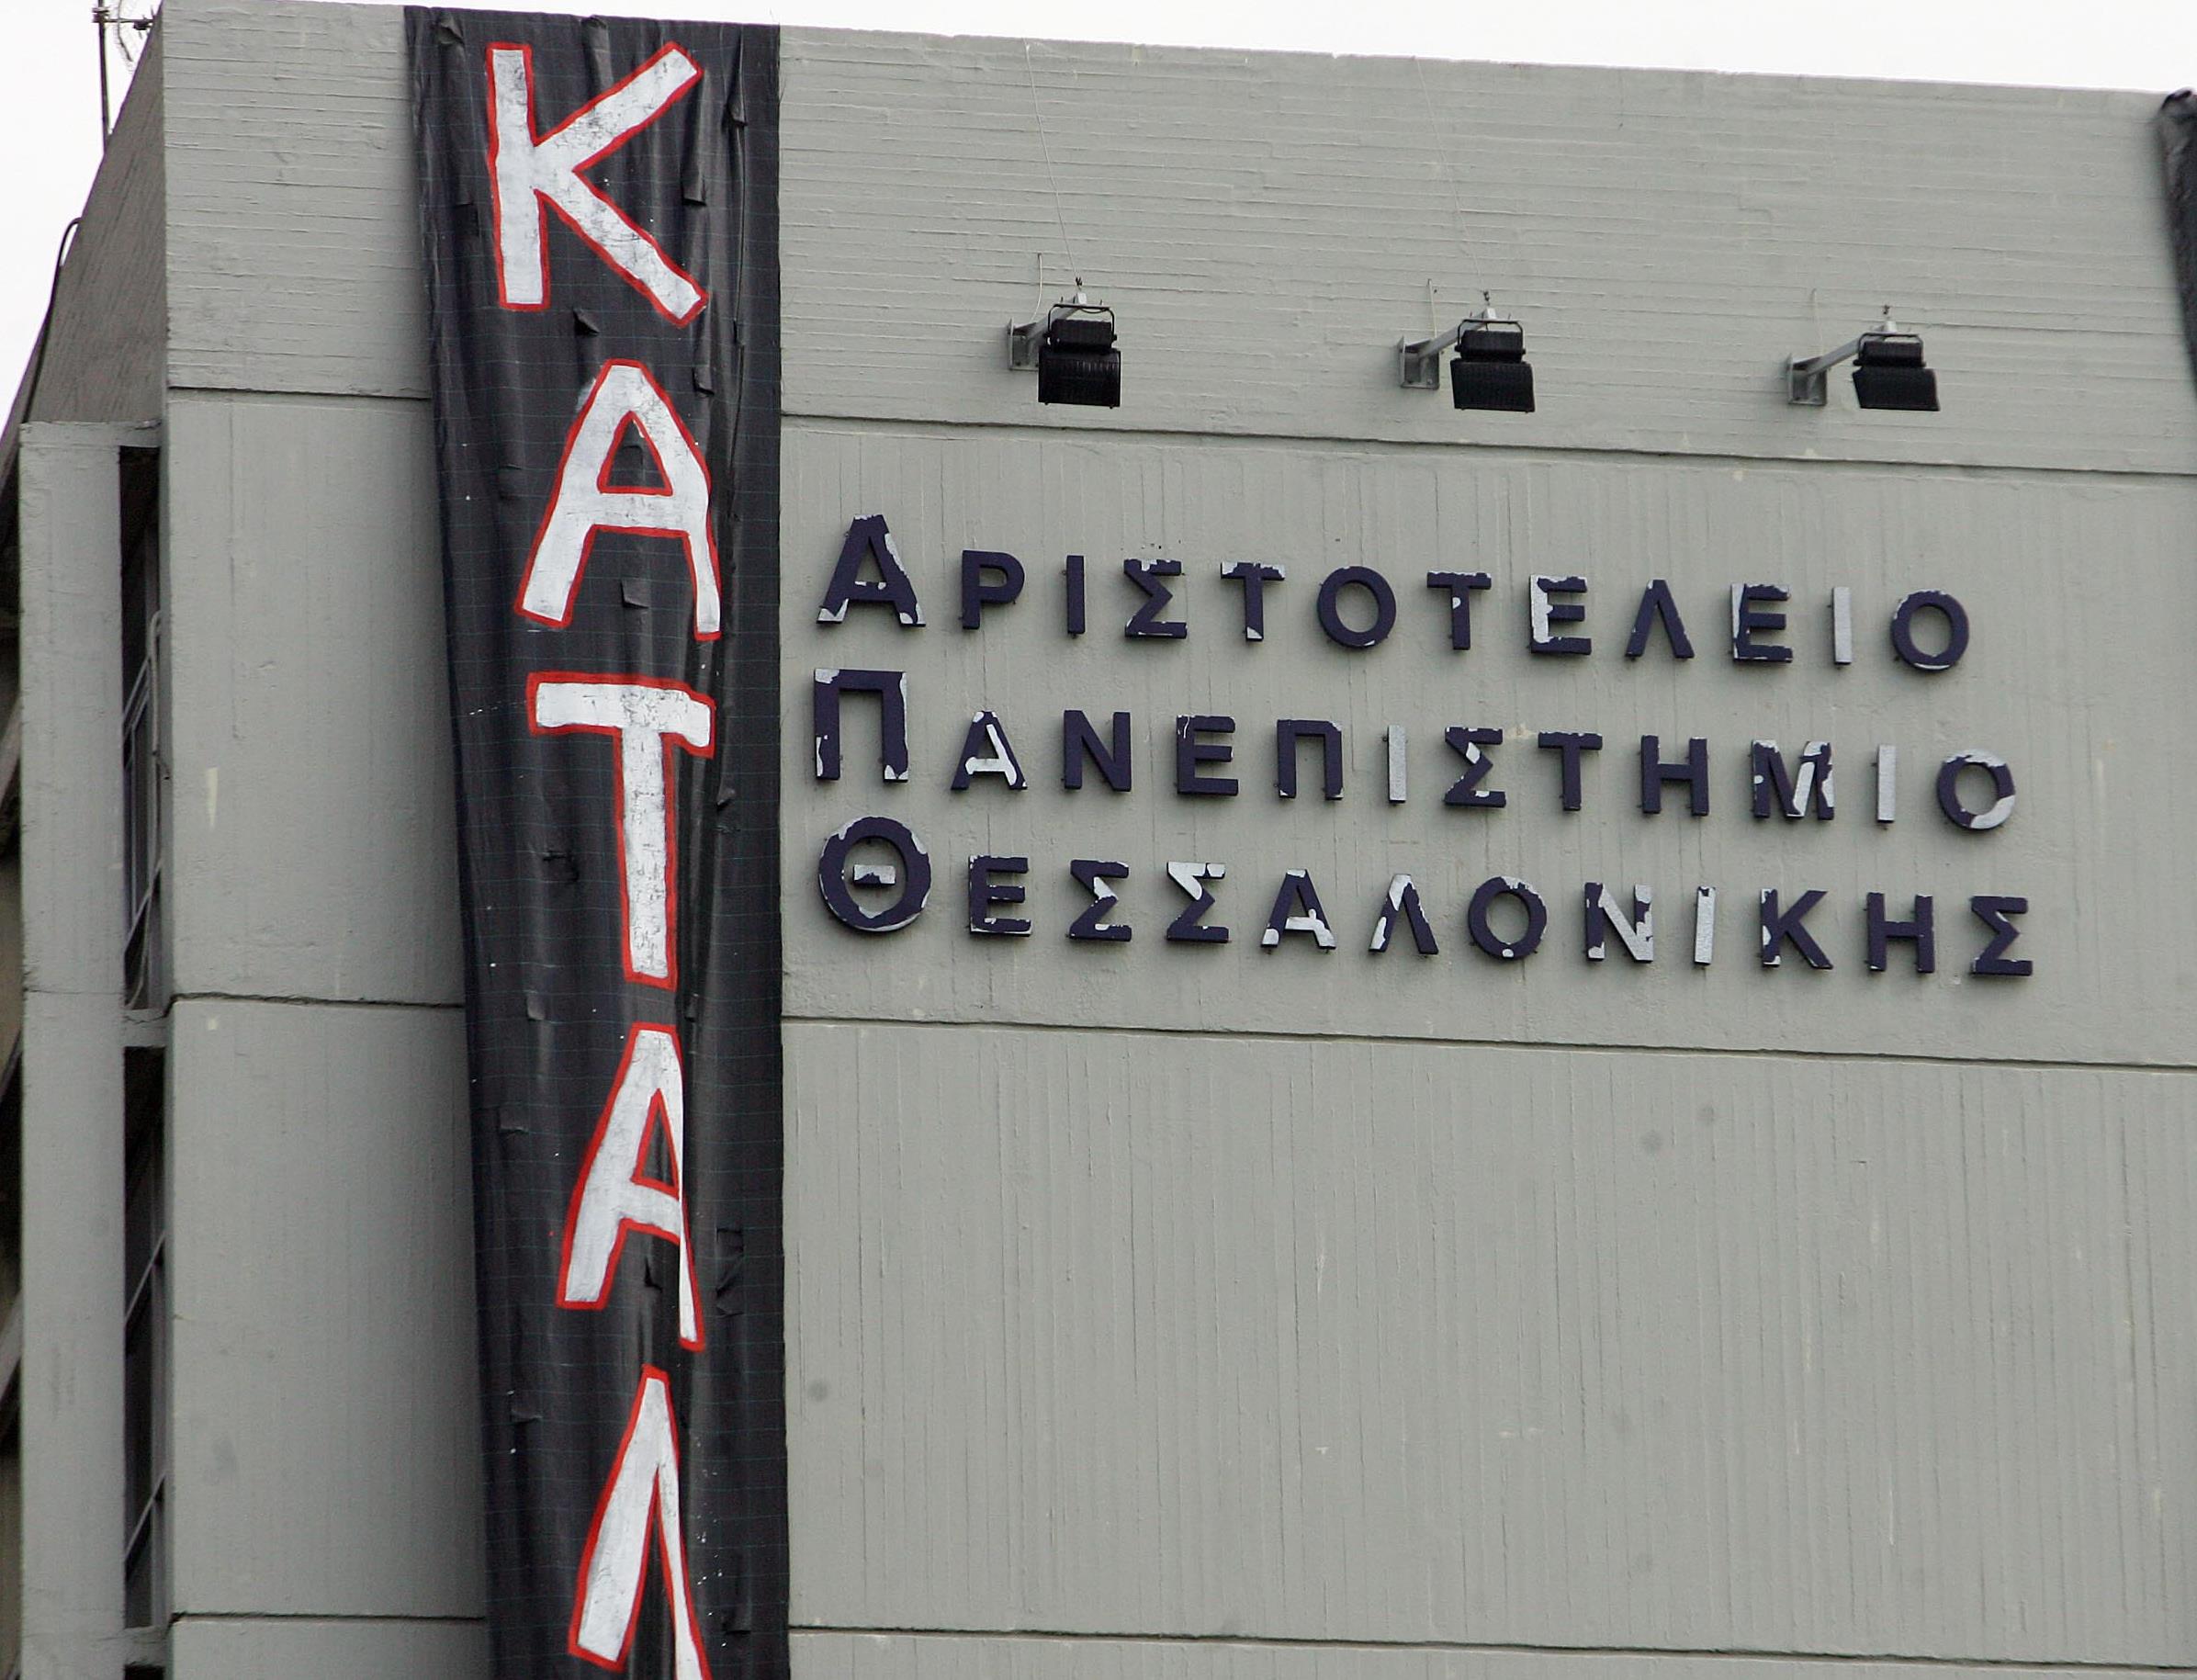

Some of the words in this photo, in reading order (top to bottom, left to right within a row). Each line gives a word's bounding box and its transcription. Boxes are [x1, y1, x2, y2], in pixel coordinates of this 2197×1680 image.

[817, 514, 1969, 674] ΑΡΙΣΤΟΤΕΛΕΙΟ
[813, 669, 2015, 833] ΠΑΝΕΠΙΣΤΗΜΙΟ
[817, 817, 2034, 976] ΘΕΣΣΑΛΟΝΙΚΗΣ
